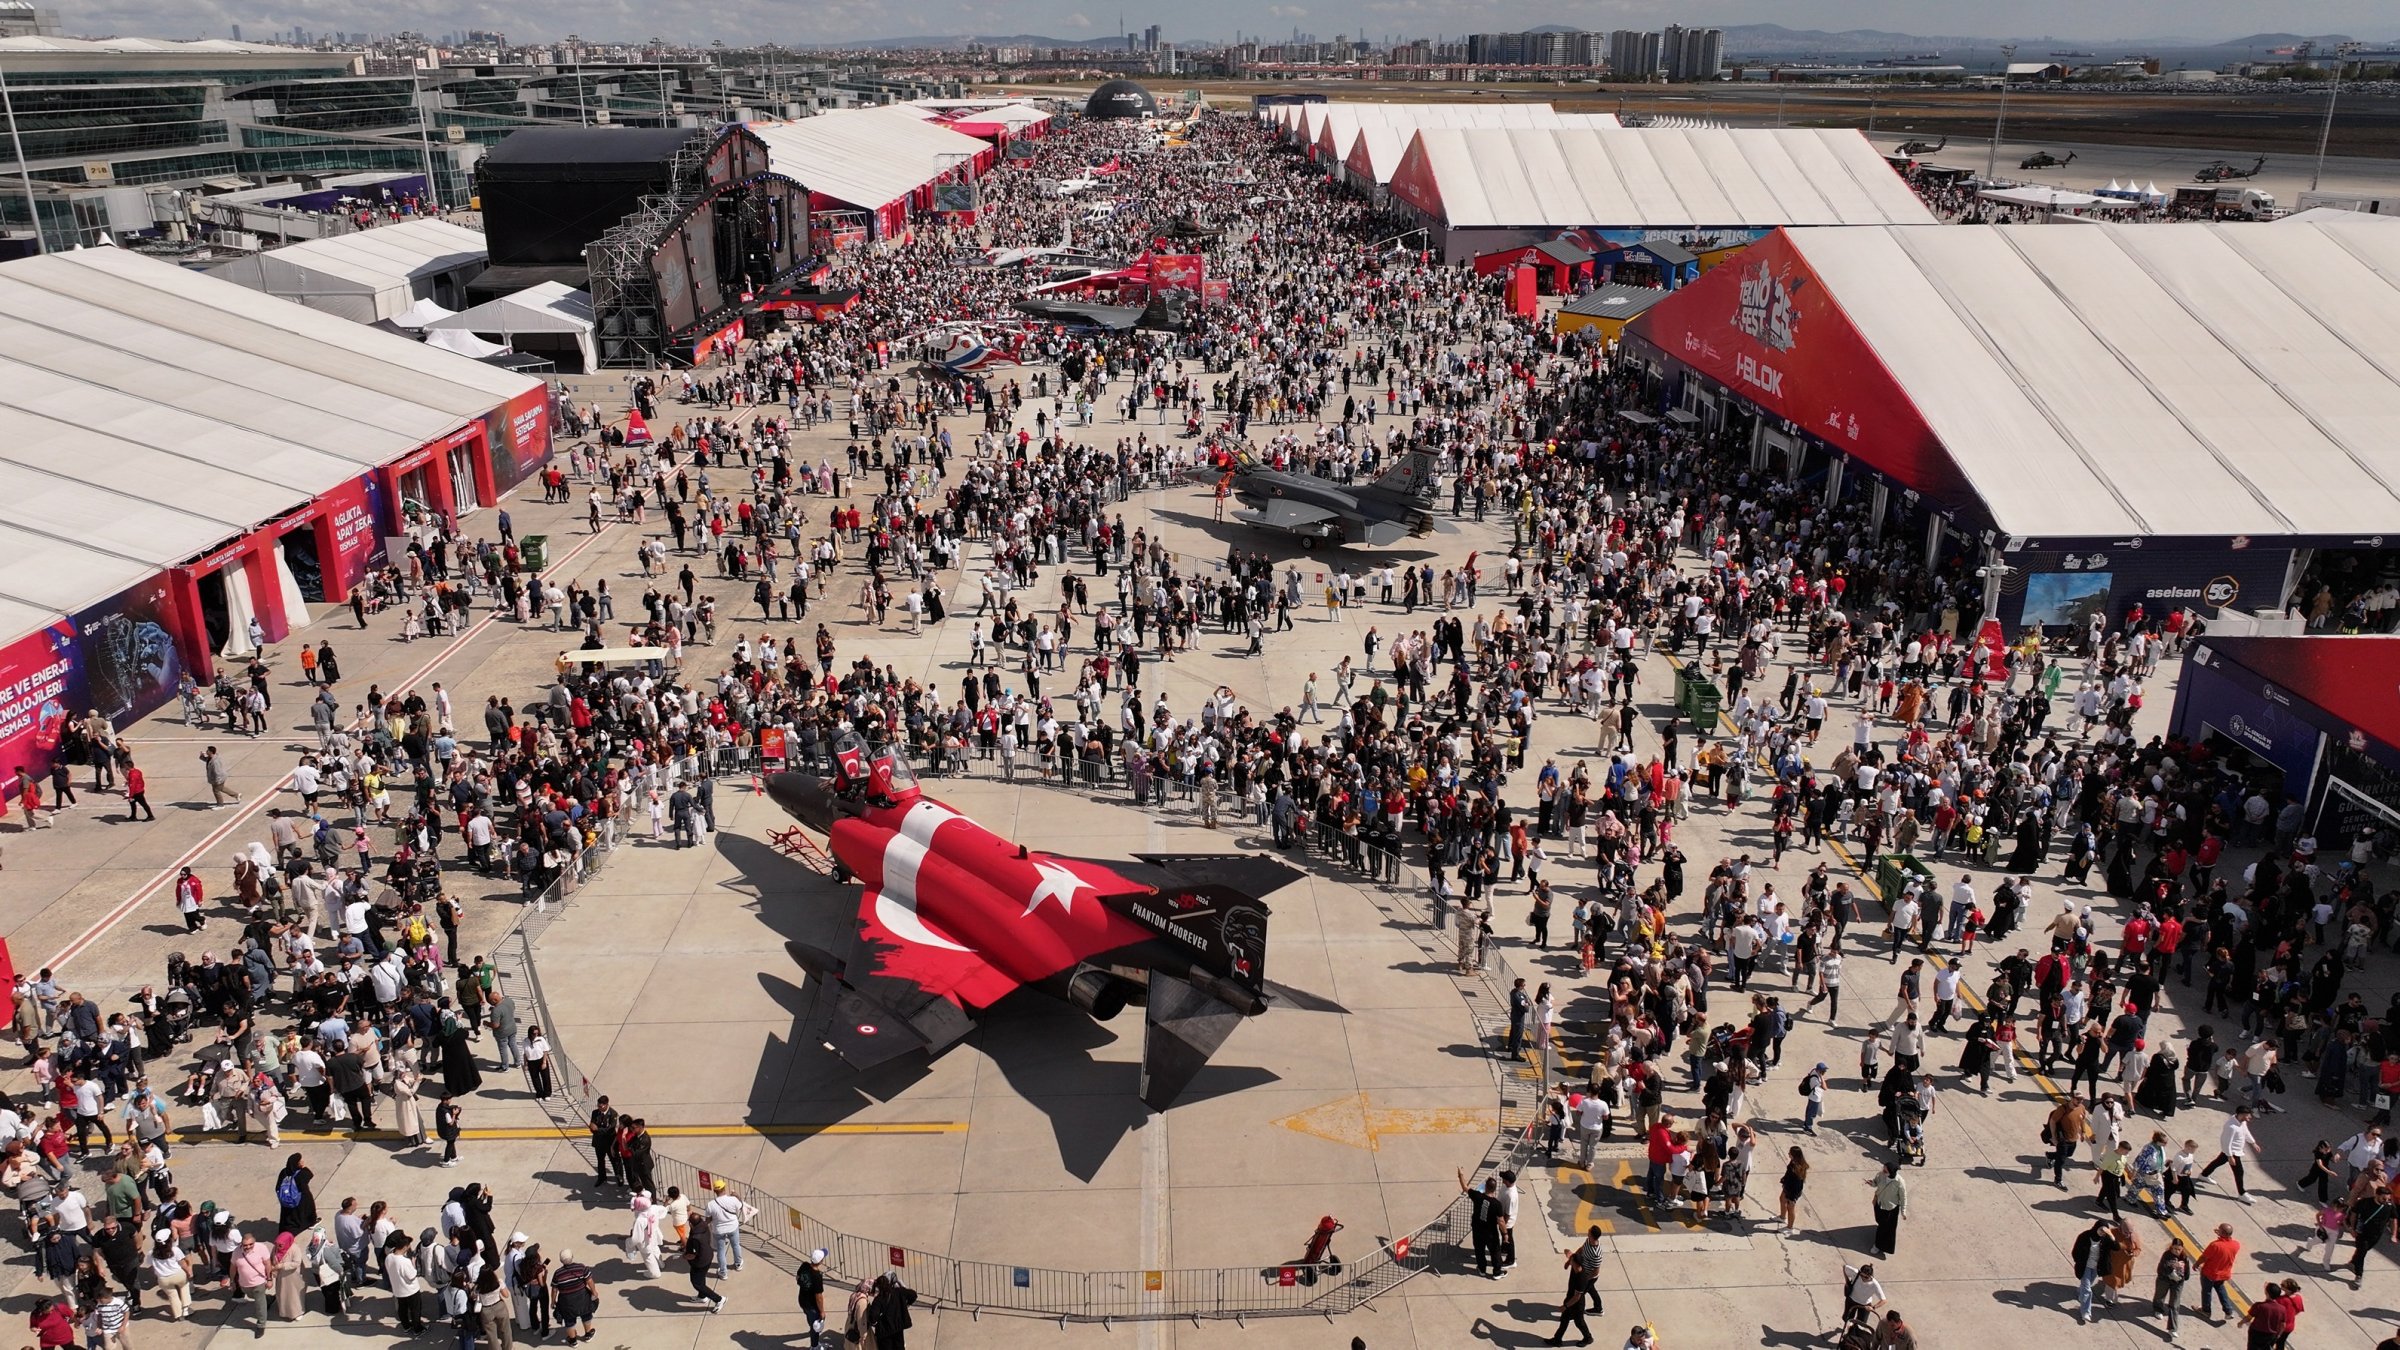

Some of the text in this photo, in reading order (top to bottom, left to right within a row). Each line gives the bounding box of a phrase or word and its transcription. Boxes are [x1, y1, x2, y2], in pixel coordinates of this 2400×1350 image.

[1736, 352, 1783, 398] I-BLOK
[2146, 586, 2201, 598] aselsan
[14, 677, 31, 696] VE
[31, 658, 69, 688] ENERJİ
[1132, 902, 1208, 951] PHANTOM PHOREVER
